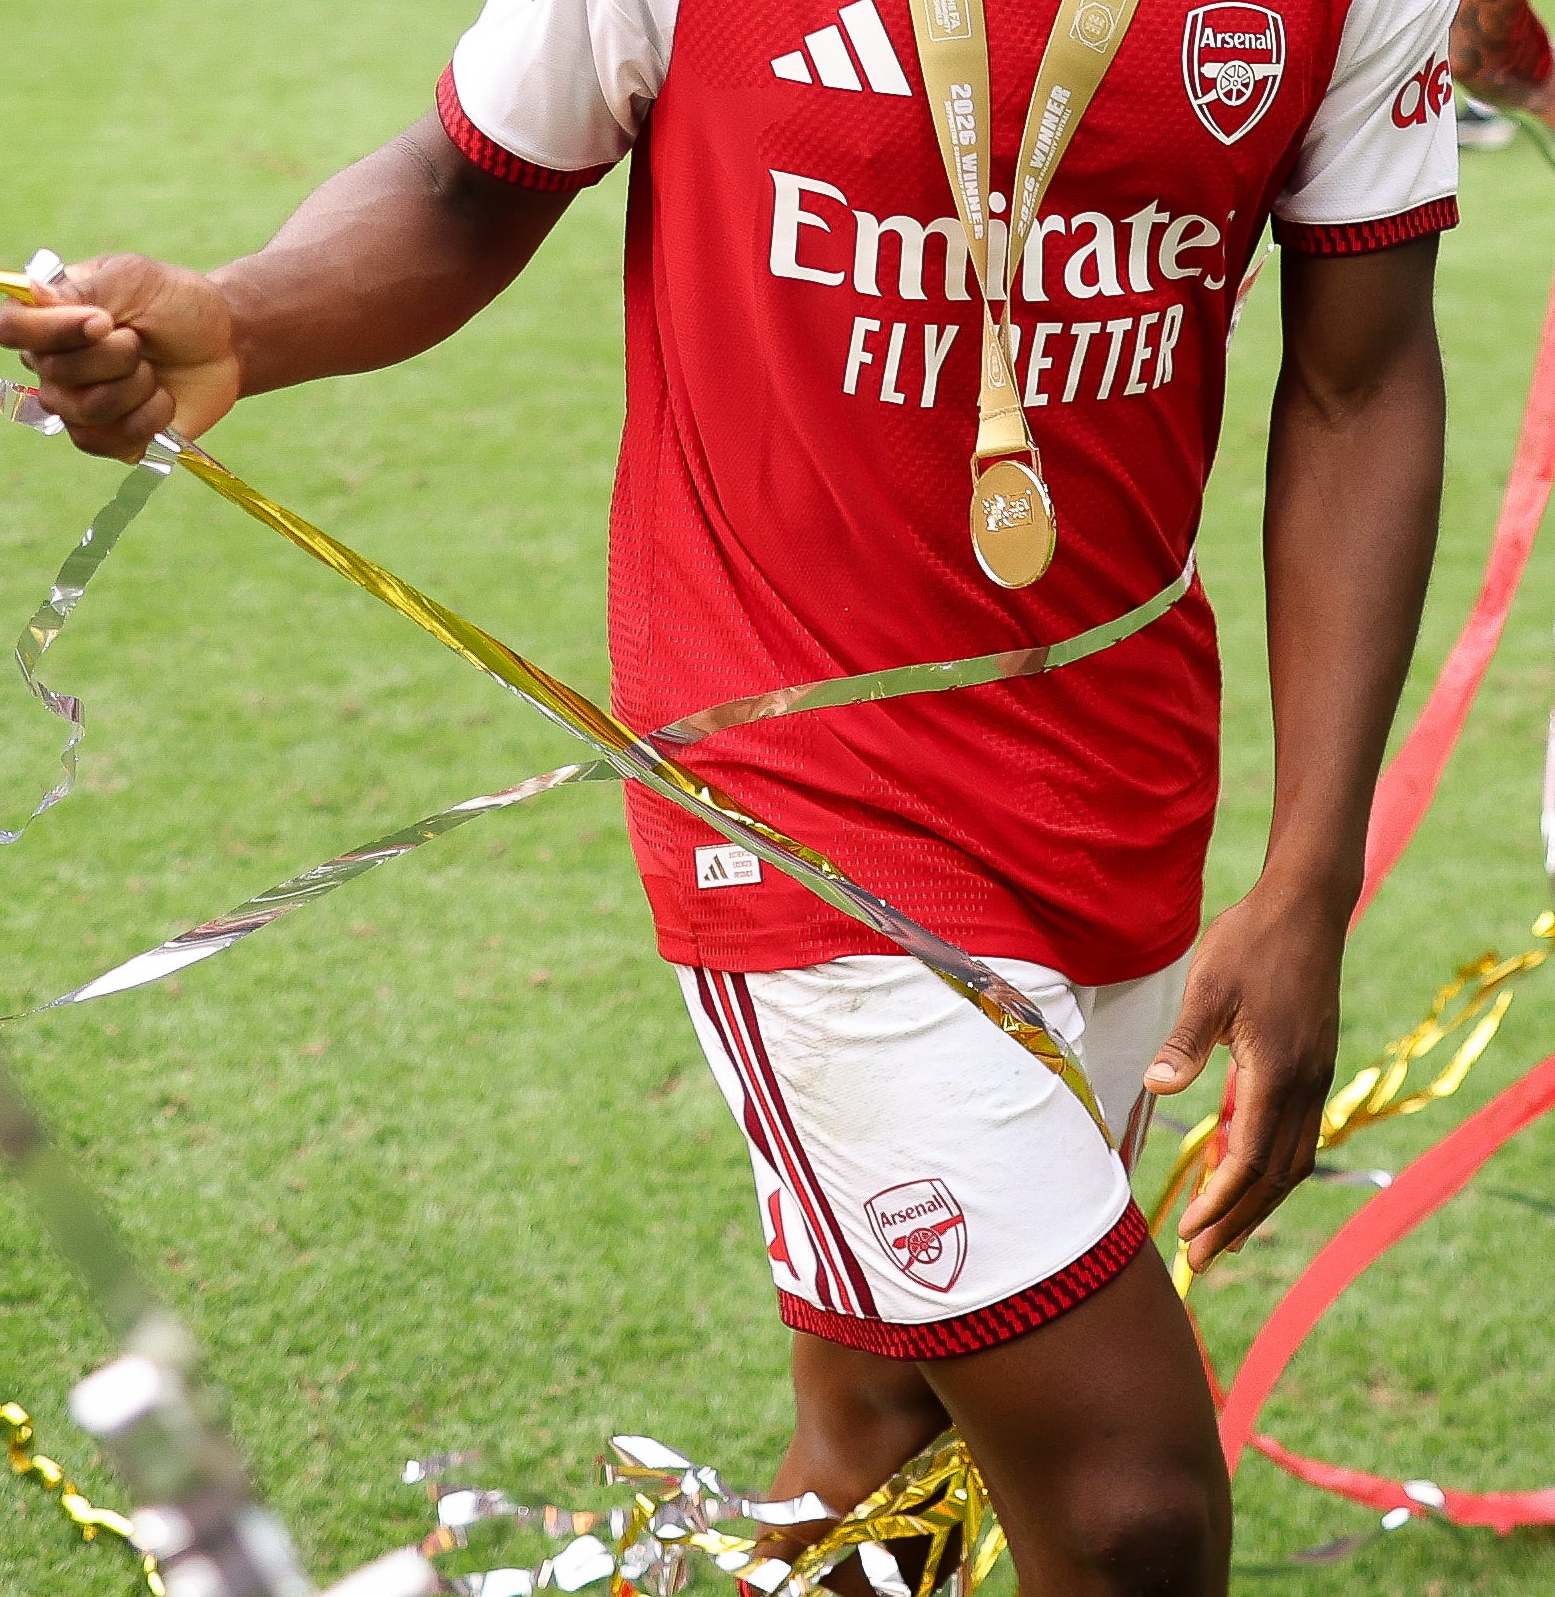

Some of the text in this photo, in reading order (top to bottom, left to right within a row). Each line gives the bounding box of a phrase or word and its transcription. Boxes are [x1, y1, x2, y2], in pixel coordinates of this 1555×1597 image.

[949, 11, 962, 30] FA
[1200, 27, 1272, 50] Arsenal
[1054, 108, 1072, 147] FOOTBALL
[950, 84, 984, 240] 2026 WINNER
[1017, 84, 1072, 238] 2026 WINNER
[842, 315, 959, 408] FLY
[879, 1194, 944, 1229] Arsenal
